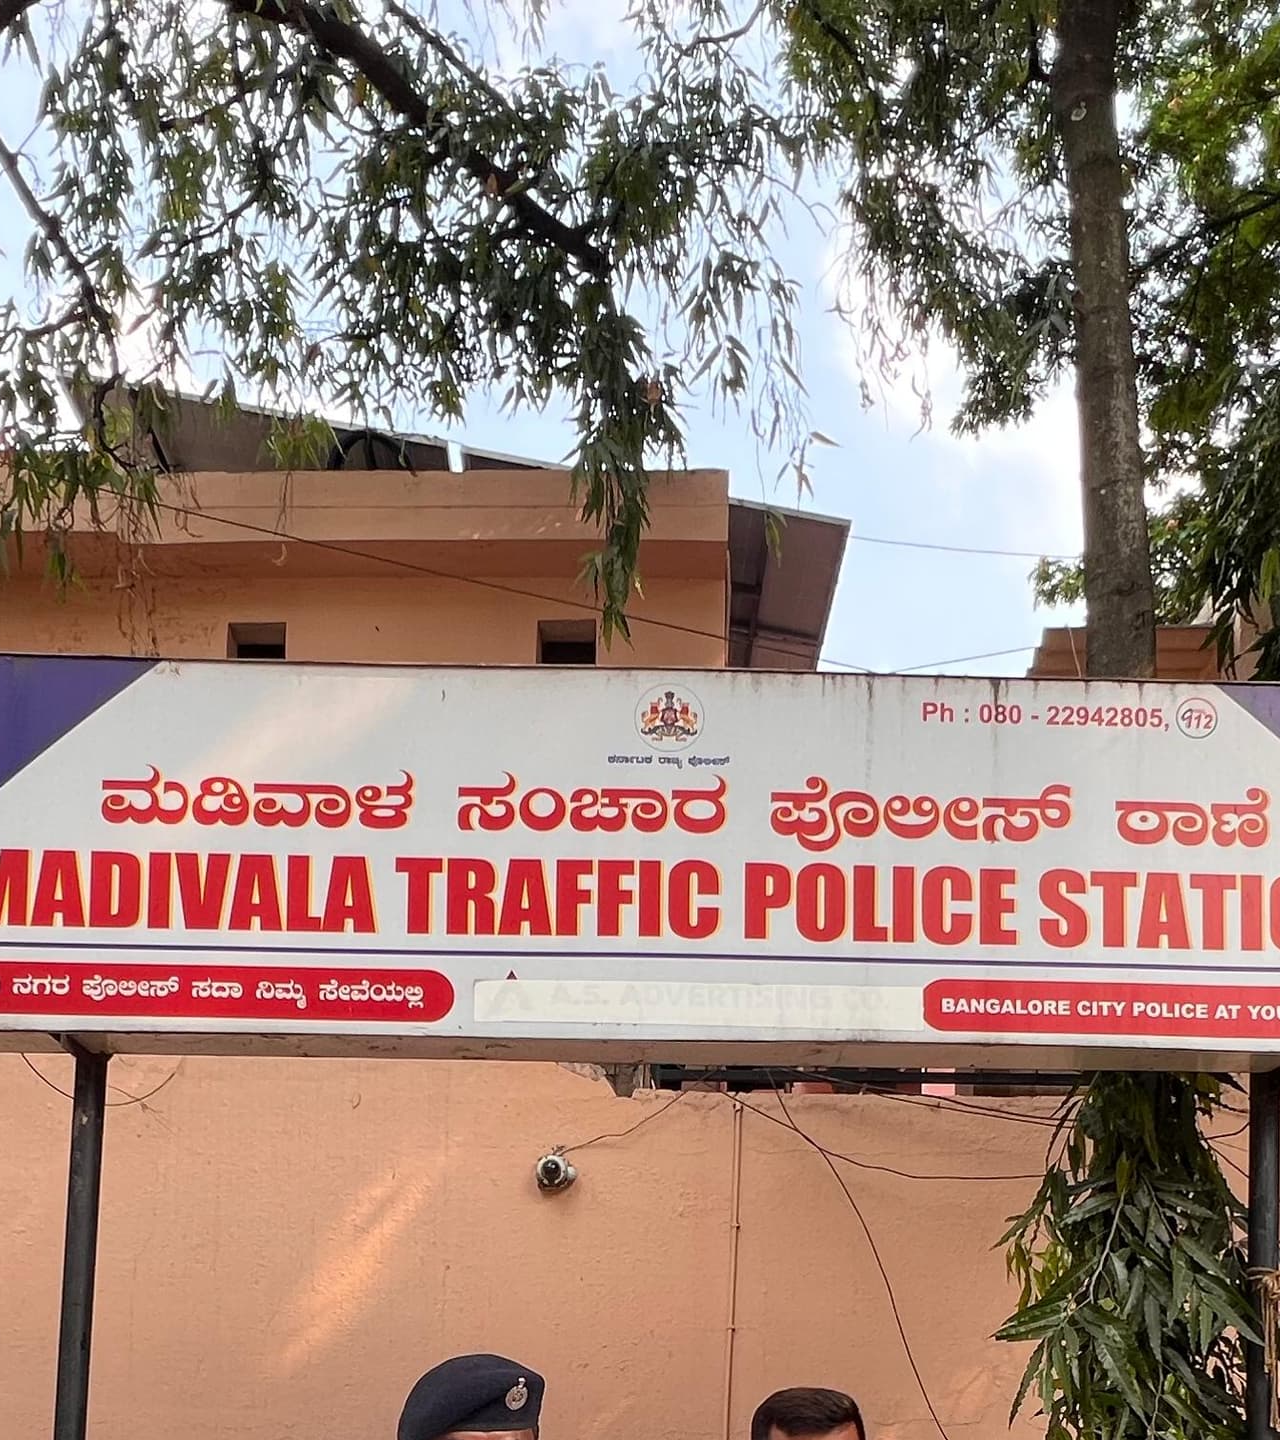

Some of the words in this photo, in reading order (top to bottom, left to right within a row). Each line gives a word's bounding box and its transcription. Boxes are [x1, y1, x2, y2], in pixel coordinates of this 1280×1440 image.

[922, 702, 954, 723] Ph
[979, 703, 1022, 725] 080
[1046, 705, 1170, 732] 22942805,
[101, 764, 414, 830] ಮಡಿವಾಳ
[457, 771, 727, 834] ಸಂಚಾರ
[770, 776, 1072, 853] ಪೊಲೀಸ್
[1114, 787, 1270, 848] ಠಾಣೆ
[395, 856, 720, 940] TRAFFIC
[744, 861, 1017, 946] POLICE
[12, 973, 70, 995] ನಗರ
[82, 974, 180, 1001] ಪೊಲೀಸ್
[191, 977, 243, 999] ಸದಾ
[255, 979, 307, 1009] ನಿಮ್ಮ
[318, 979, 424, 1009] ಸೇವೆಯಲ್ಲಿ
[941, 997, 1071, 1016] BANGALORE
[1076, 1000, 1127, 1018] CITY
[1132, 1001, 1209, 1019] POLICE
[1214, 1004, 1242, 1020] AT
